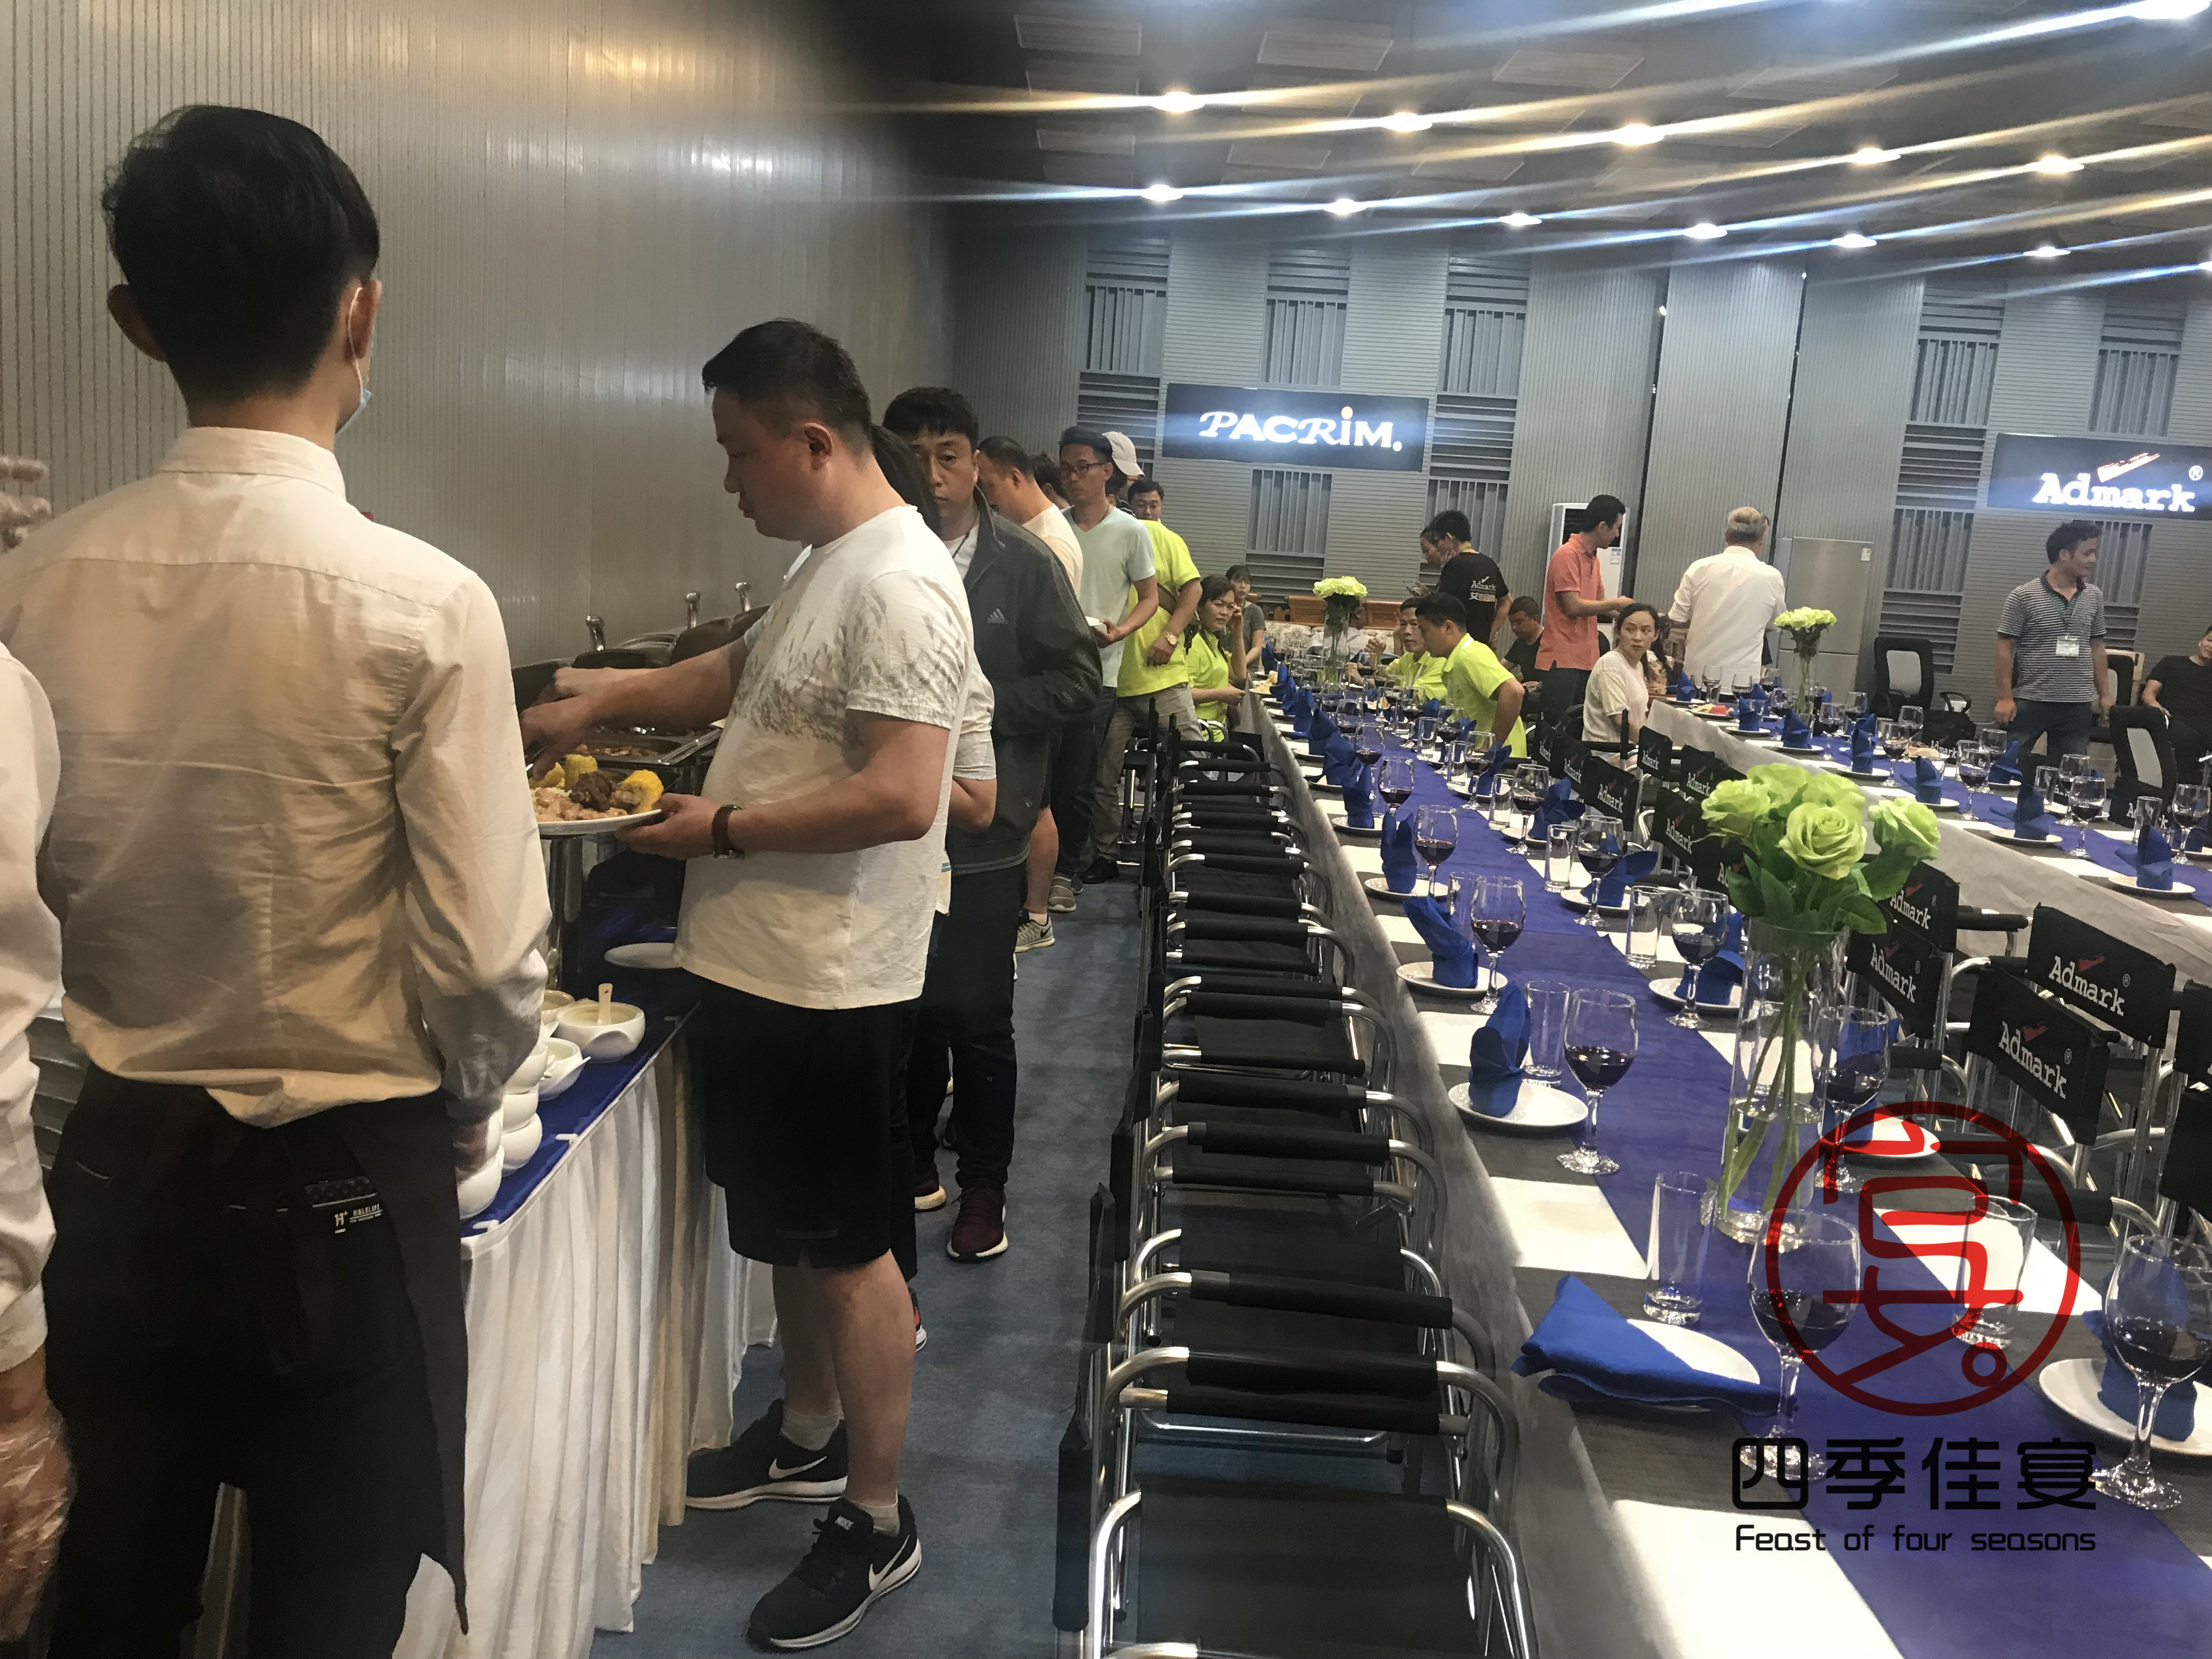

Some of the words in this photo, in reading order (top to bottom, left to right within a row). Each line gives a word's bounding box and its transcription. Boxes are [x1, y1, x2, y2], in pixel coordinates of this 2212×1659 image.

[2033, 472, 2195, 512] Admark
[1597, 783, 1623, 814] Admark
[1686, 772, 1711, 797] Admark
[1666, 818, 1692, 854] Admark
[1889, 891, 1931, 931] Admark
[1870, 943, 1917, 1004] Admark
[2049, 956, 2125, 1017] Admark
[1999, 1021, 2068, 1099] Admark
